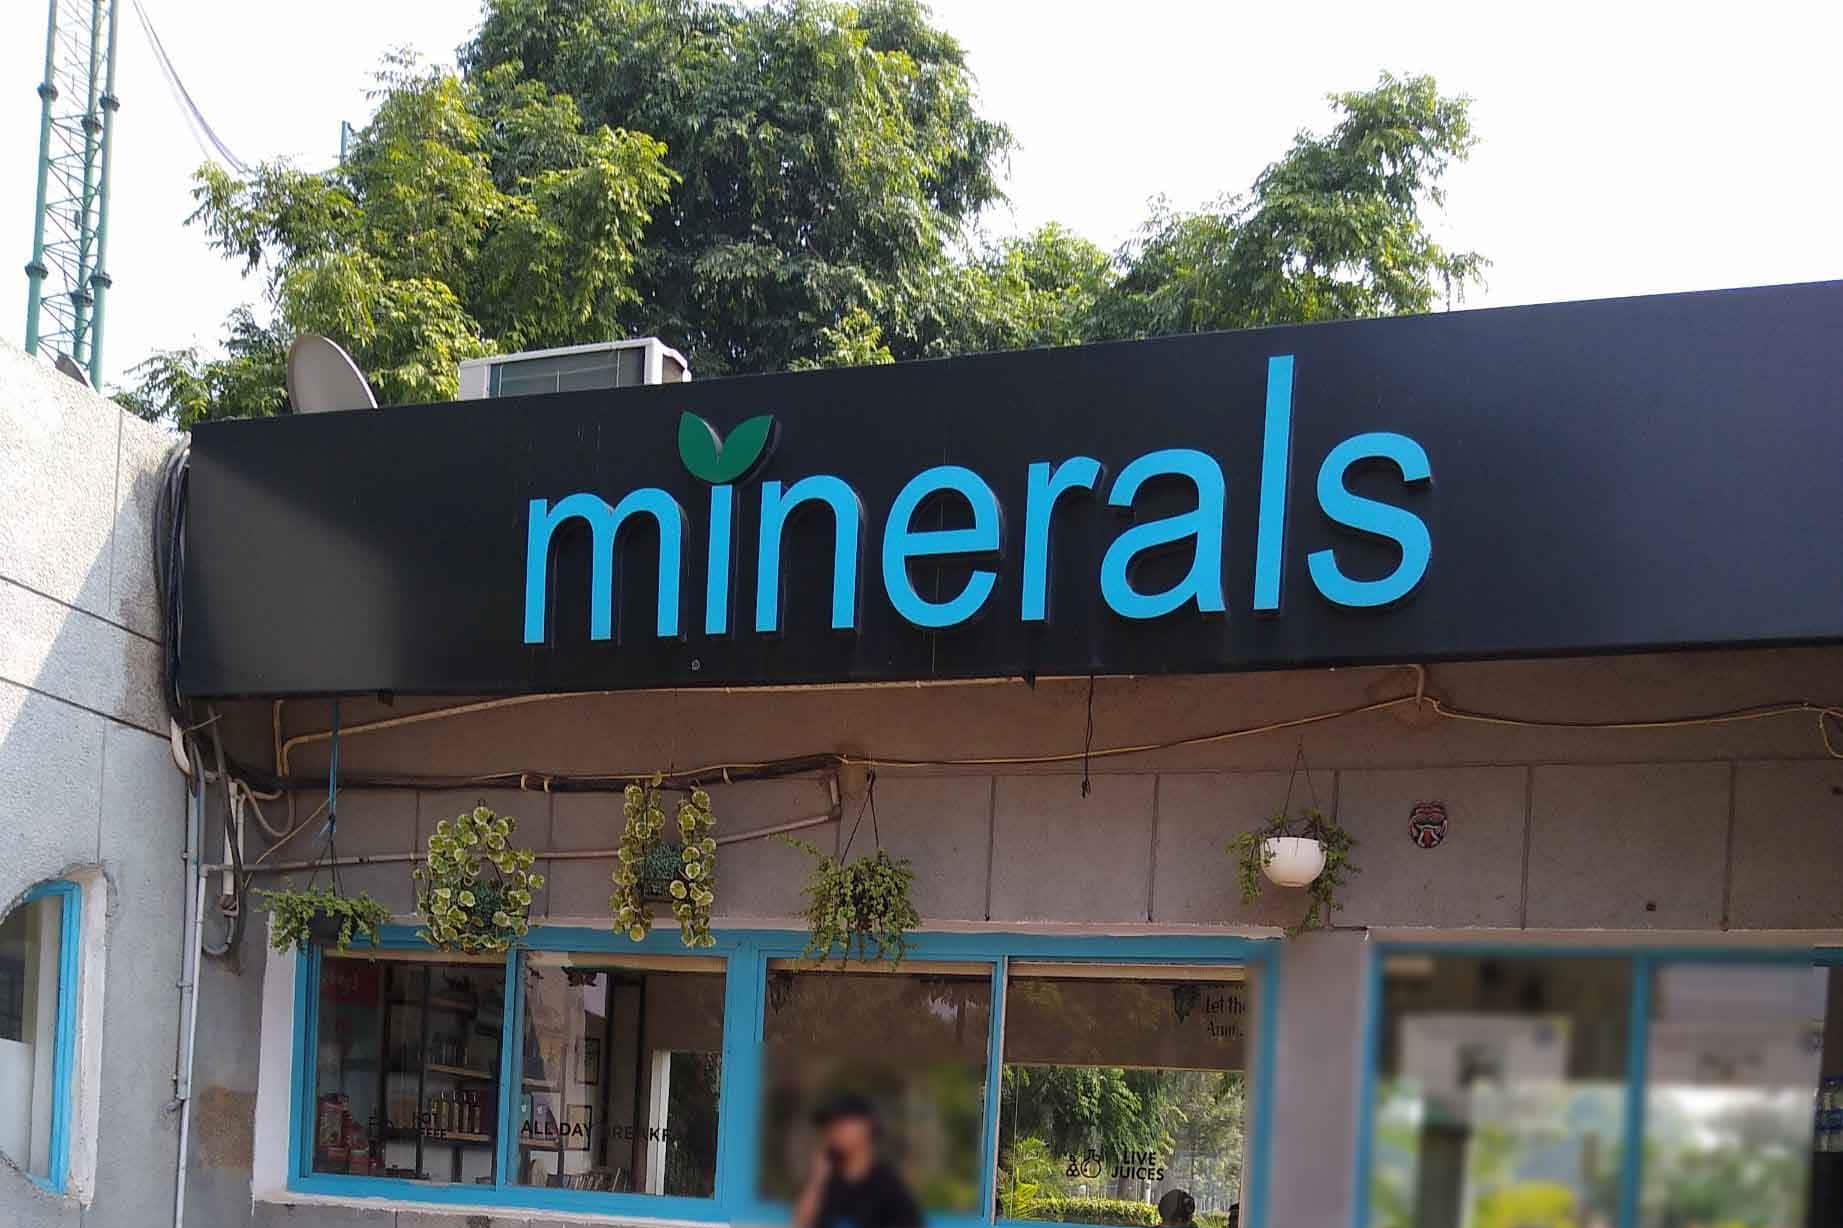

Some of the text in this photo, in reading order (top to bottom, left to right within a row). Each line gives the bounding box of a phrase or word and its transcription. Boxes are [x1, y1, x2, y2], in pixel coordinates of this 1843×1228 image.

[522, 354, 1433, 645] minerals
[520, 1119, 555, 1137] ALL
[559, 1121, 593, 1138] DAY
[1122, 1150, 1157, 1166] LIVE
[1111, 1166, 1165, 1181] JUICES
